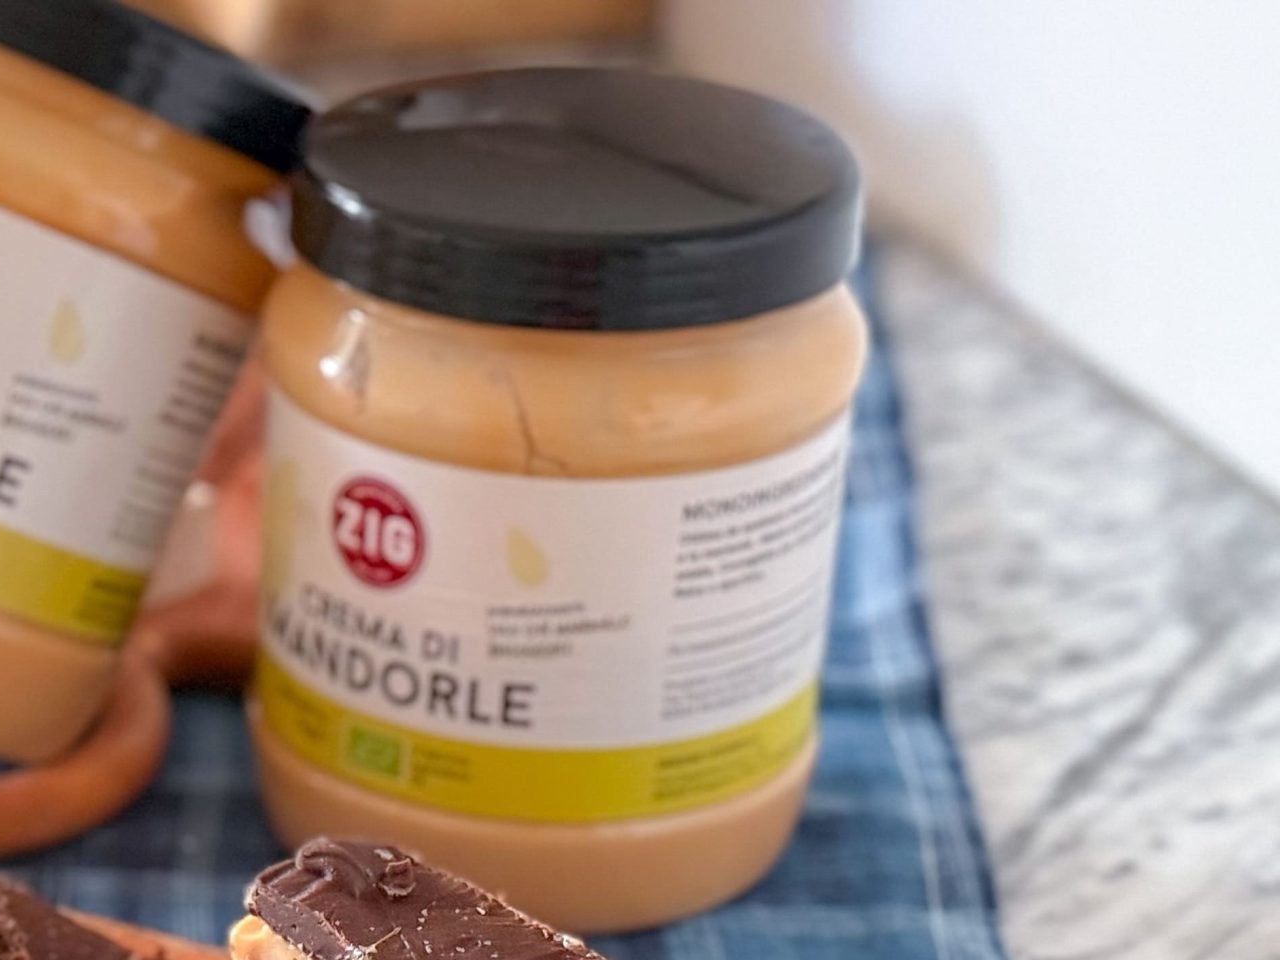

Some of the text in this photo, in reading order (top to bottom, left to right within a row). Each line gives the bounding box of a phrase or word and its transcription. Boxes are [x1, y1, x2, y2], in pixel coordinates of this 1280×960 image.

[334, 499, 417, 567] ZIG
[299, 583, 460, 675] CREMA DI
